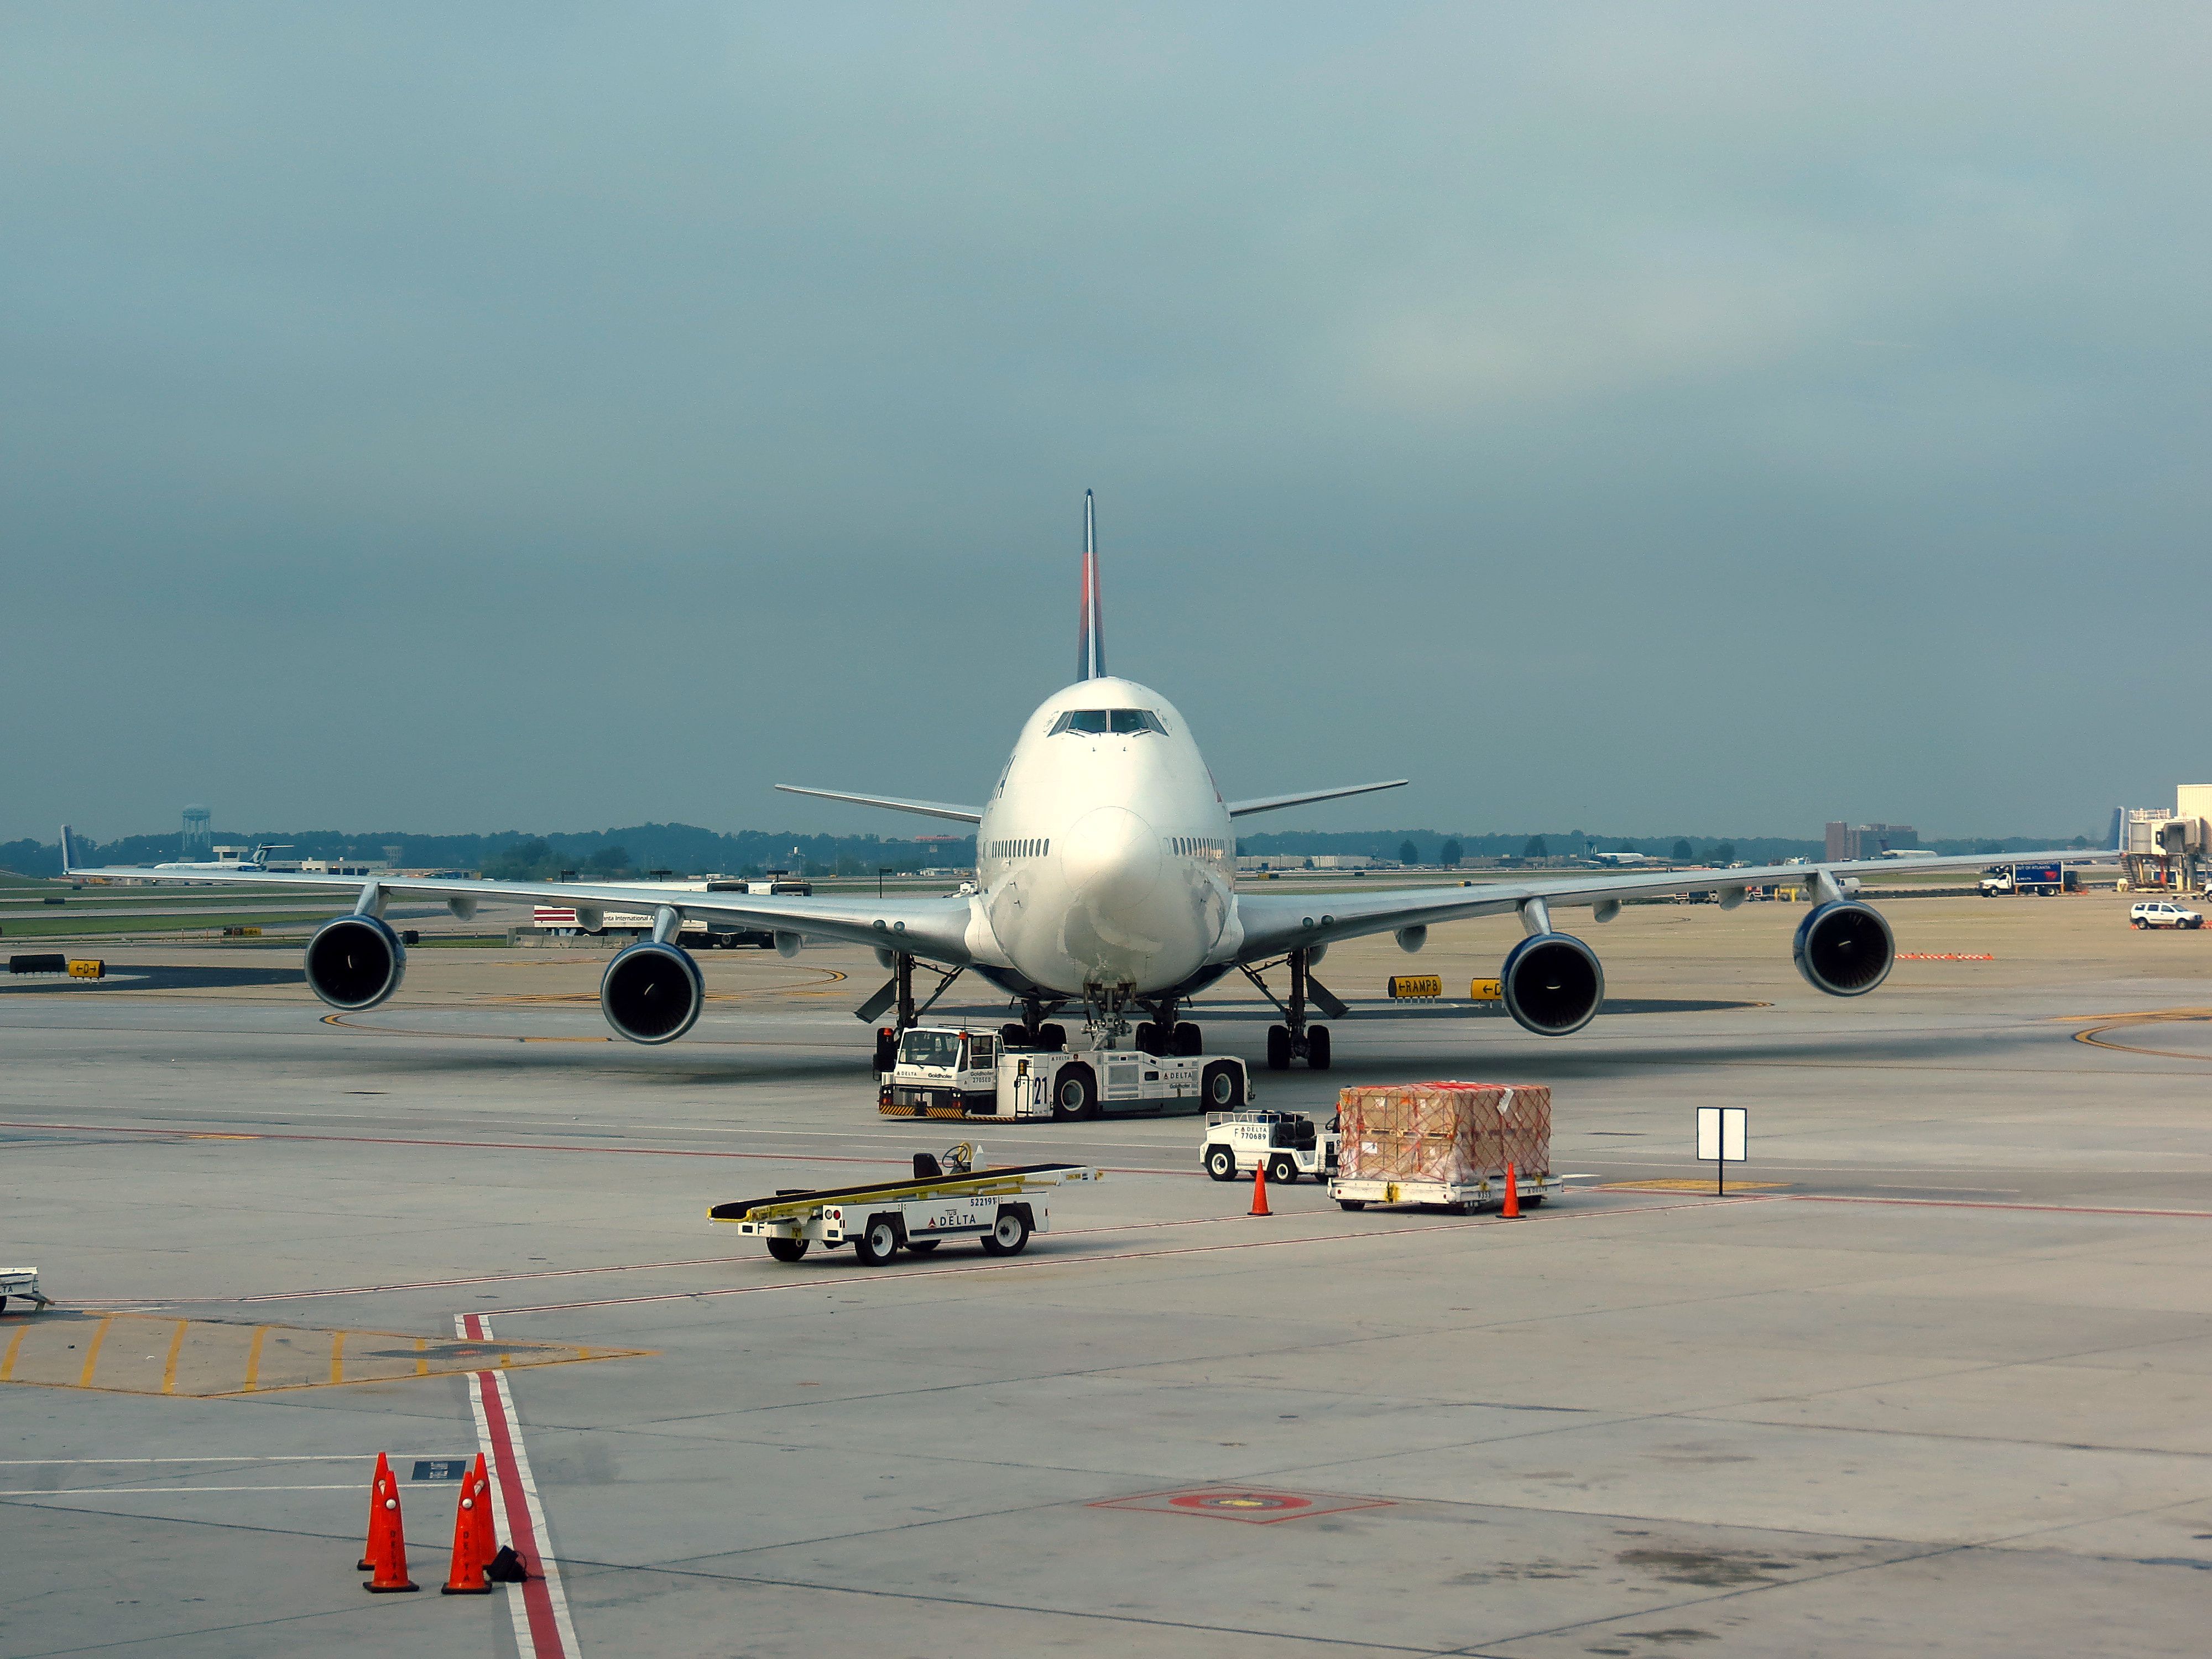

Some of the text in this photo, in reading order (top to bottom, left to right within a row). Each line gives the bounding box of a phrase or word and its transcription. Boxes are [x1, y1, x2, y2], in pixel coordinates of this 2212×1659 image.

[84, 964, 88, 973] D
[1034, 1076, 1047, 1105] 21
[1234, 1129, 1238, 1137] F
[971, 1197, 995, 1206] 522191
[940, 1214, 976, 1227] DELTA
